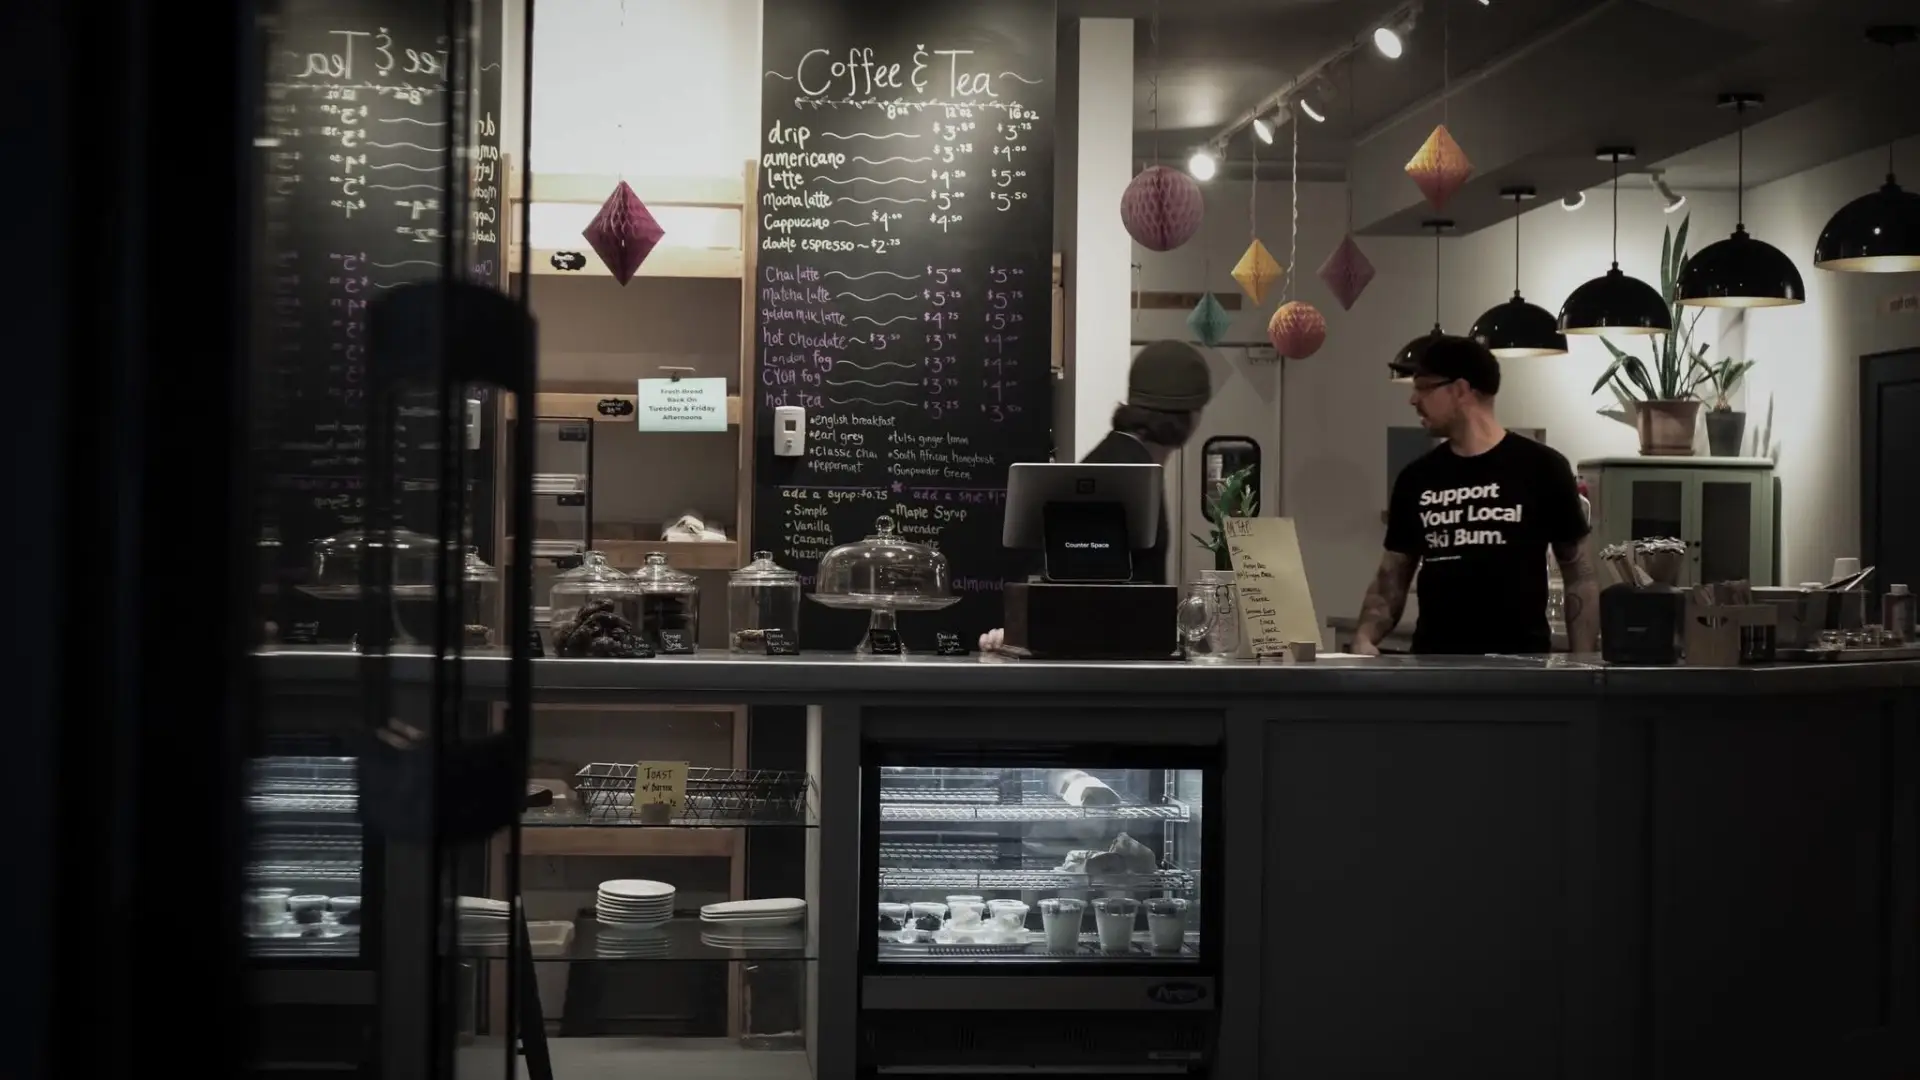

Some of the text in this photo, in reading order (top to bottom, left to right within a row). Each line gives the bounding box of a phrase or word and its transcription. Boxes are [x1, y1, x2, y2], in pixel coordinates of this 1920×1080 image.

[798, 48, 902, 96] Coffee
[934, 50, 998, 97] Tea
[768, 119, 811, 150] drip
[763, 151, 846, 169] americano
[768, 168, 804, 190] latte
[764, 213, 831, 234] Cappuccino
[762, 236, 798, 252] double
[801, 239, 855, 252] espresso
[763, 326, 785, 347] hot
[763, 347, 806, 367] London
[766, 389, 788, 408] hot
[796, 389, 824, 408] tea
[852, 413, 897, 428] breakfast
[840, 432, 864, 447] grey
[782, 488, 808, 499] add
[1419, 482, 1500, 506] Support
[794, 500, 967, 522] Simple Maple Syrup
[1419, 504, 1522, 528] Your Local
[793, 519, 945, 535] Vanilla Lavender
[792, 534, 834, 546] Caramel
[1091, 541, 1110, 550] Space
[1425, 528, 1507, 549] Ski Bum.
[644, 767, 673, 780] TOAST
